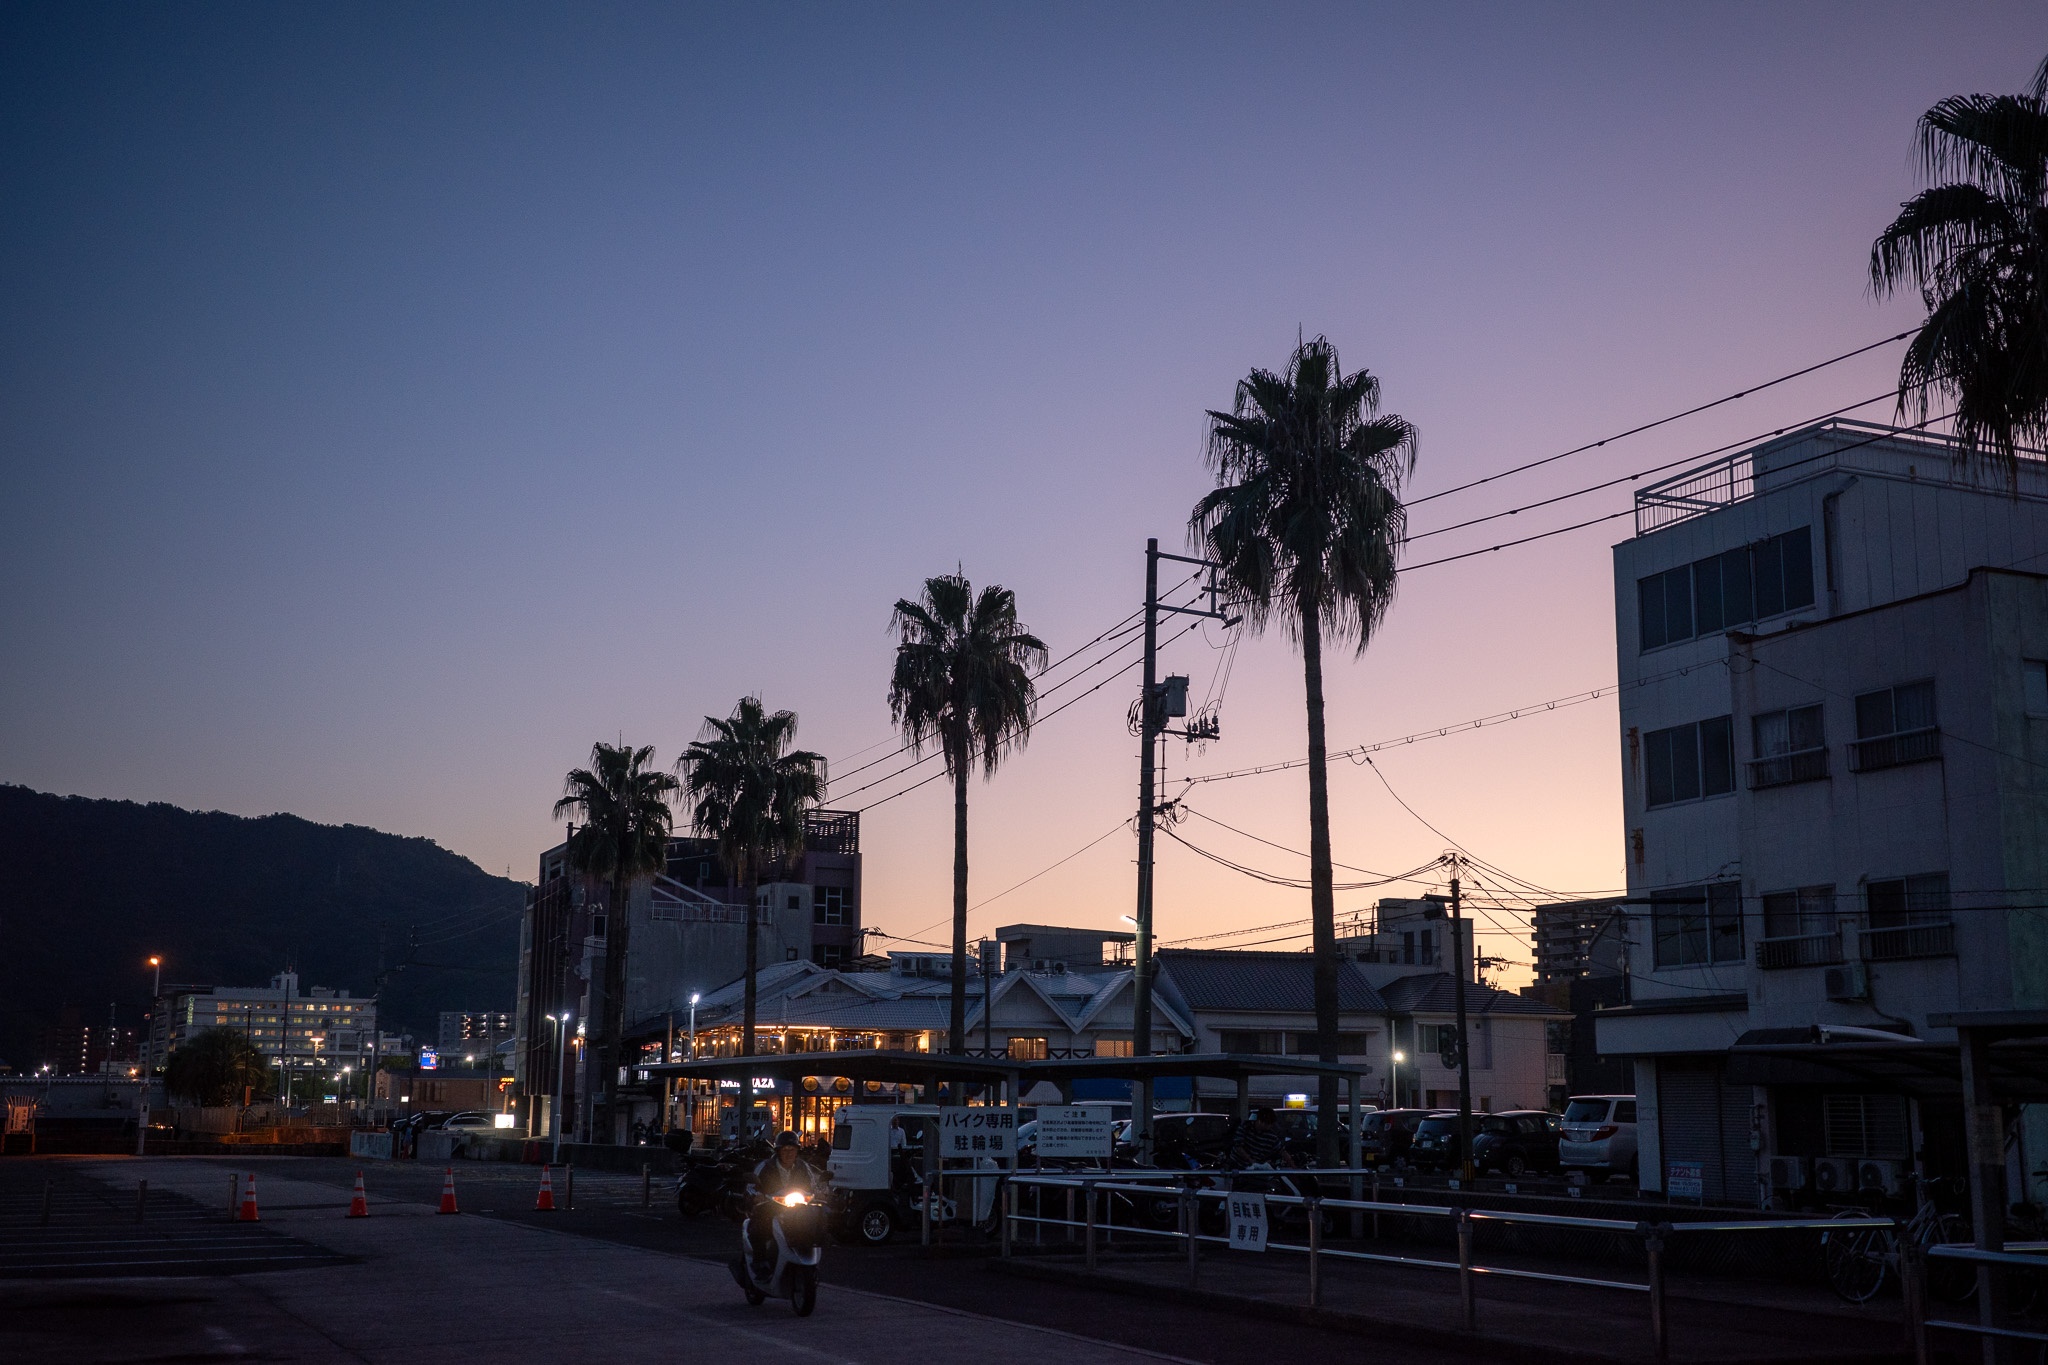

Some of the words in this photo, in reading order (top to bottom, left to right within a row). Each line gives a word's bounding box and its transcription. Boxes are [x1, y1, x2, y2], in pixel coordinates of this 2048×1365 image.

[945, 1113, 1013, 1128] バイク専用
[1063, 1110, 1087, 1118] ご注意
[954, 1135, 1003, 1150] 駐輪場
[1232, 1202, 1261, 1218] 自転車
[1237, 1225, 1259, 1241] 専用
